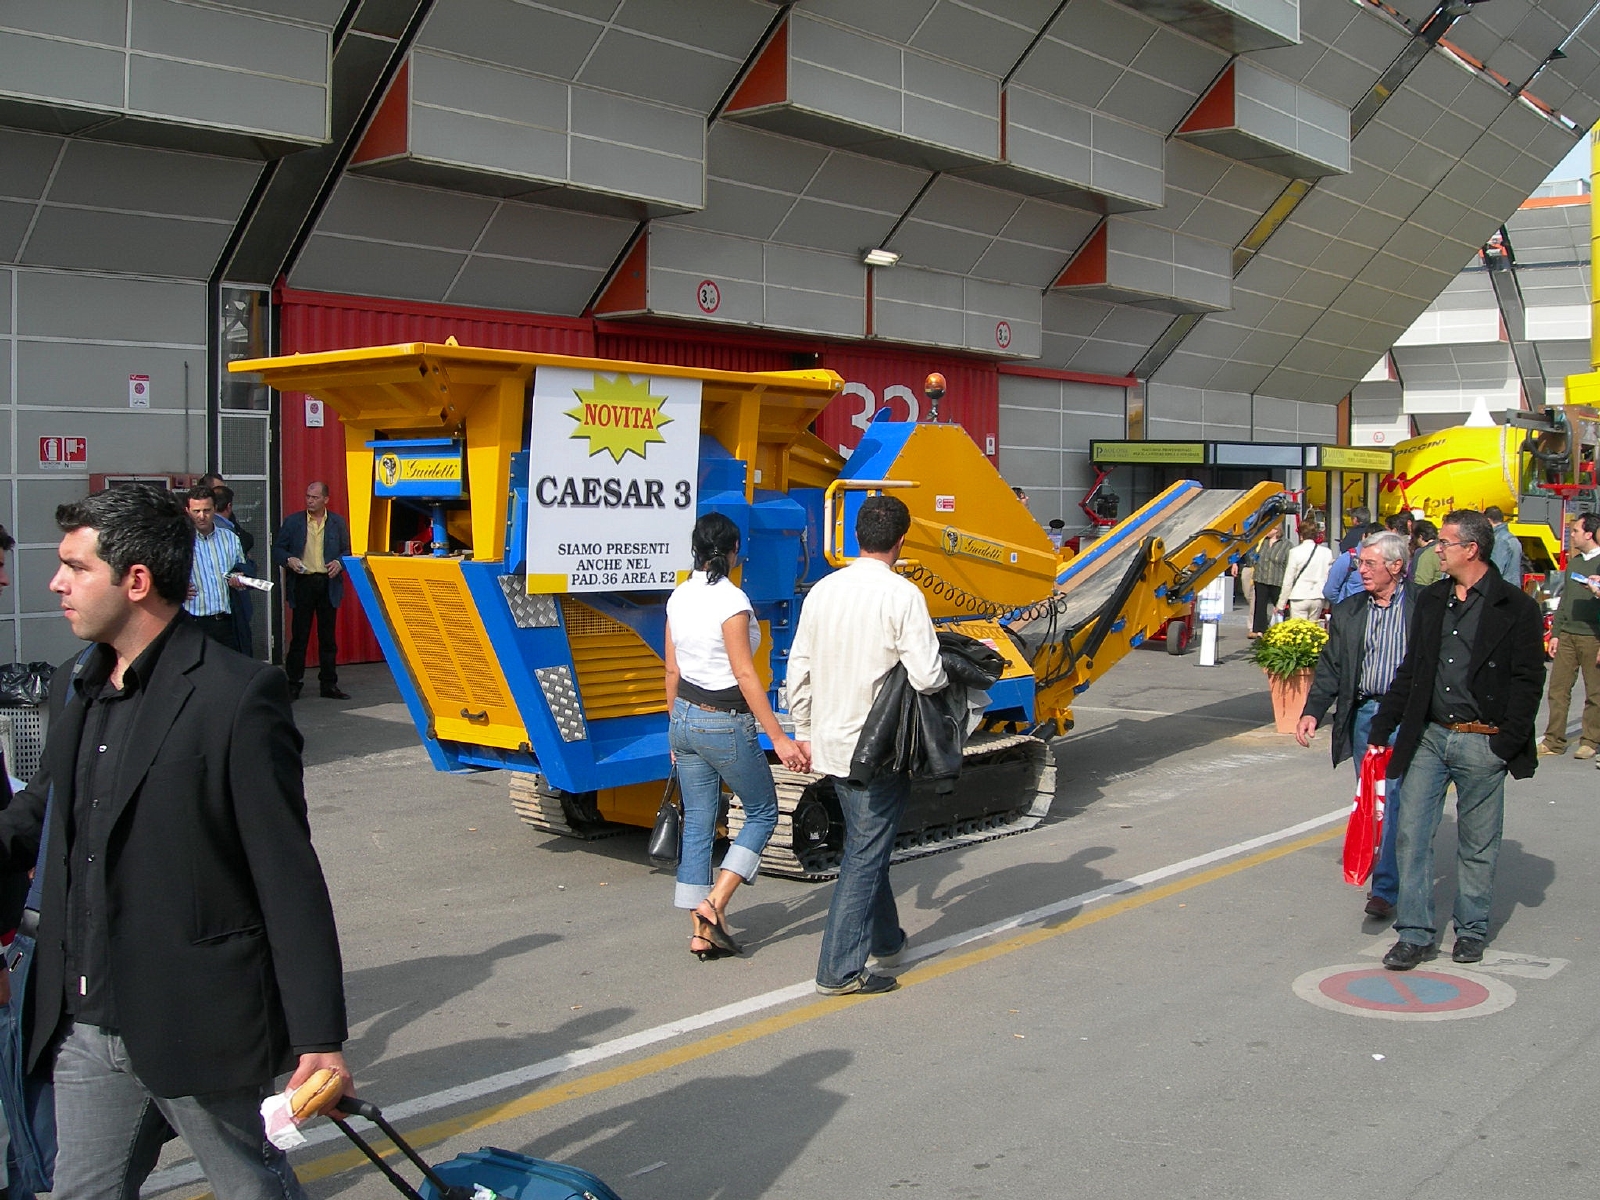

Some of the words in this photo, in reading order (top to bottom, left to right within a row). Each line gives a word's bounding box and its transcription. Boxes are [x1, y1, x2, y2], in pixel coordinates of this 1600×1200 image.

[584, 403, 656, 429] NOVITA'
[407, 460, 458, 478] Guidetti
[535, 475, 665, 508] CAESAR
[674, 479, 691, 509] 3
[558, 543, 602, 555] SIAMO
[607, 543, 669, 555] PRESENTI
[965, 539, 1002, 559] Guidetti
[576, 559, 622, 571] ANCHE
[626, 558, 651, 570] NEL
[571, 573, 618, 585] PAD.36
[621, 572, 656, 584] AREA
[660, 571, 675, 583] E2
